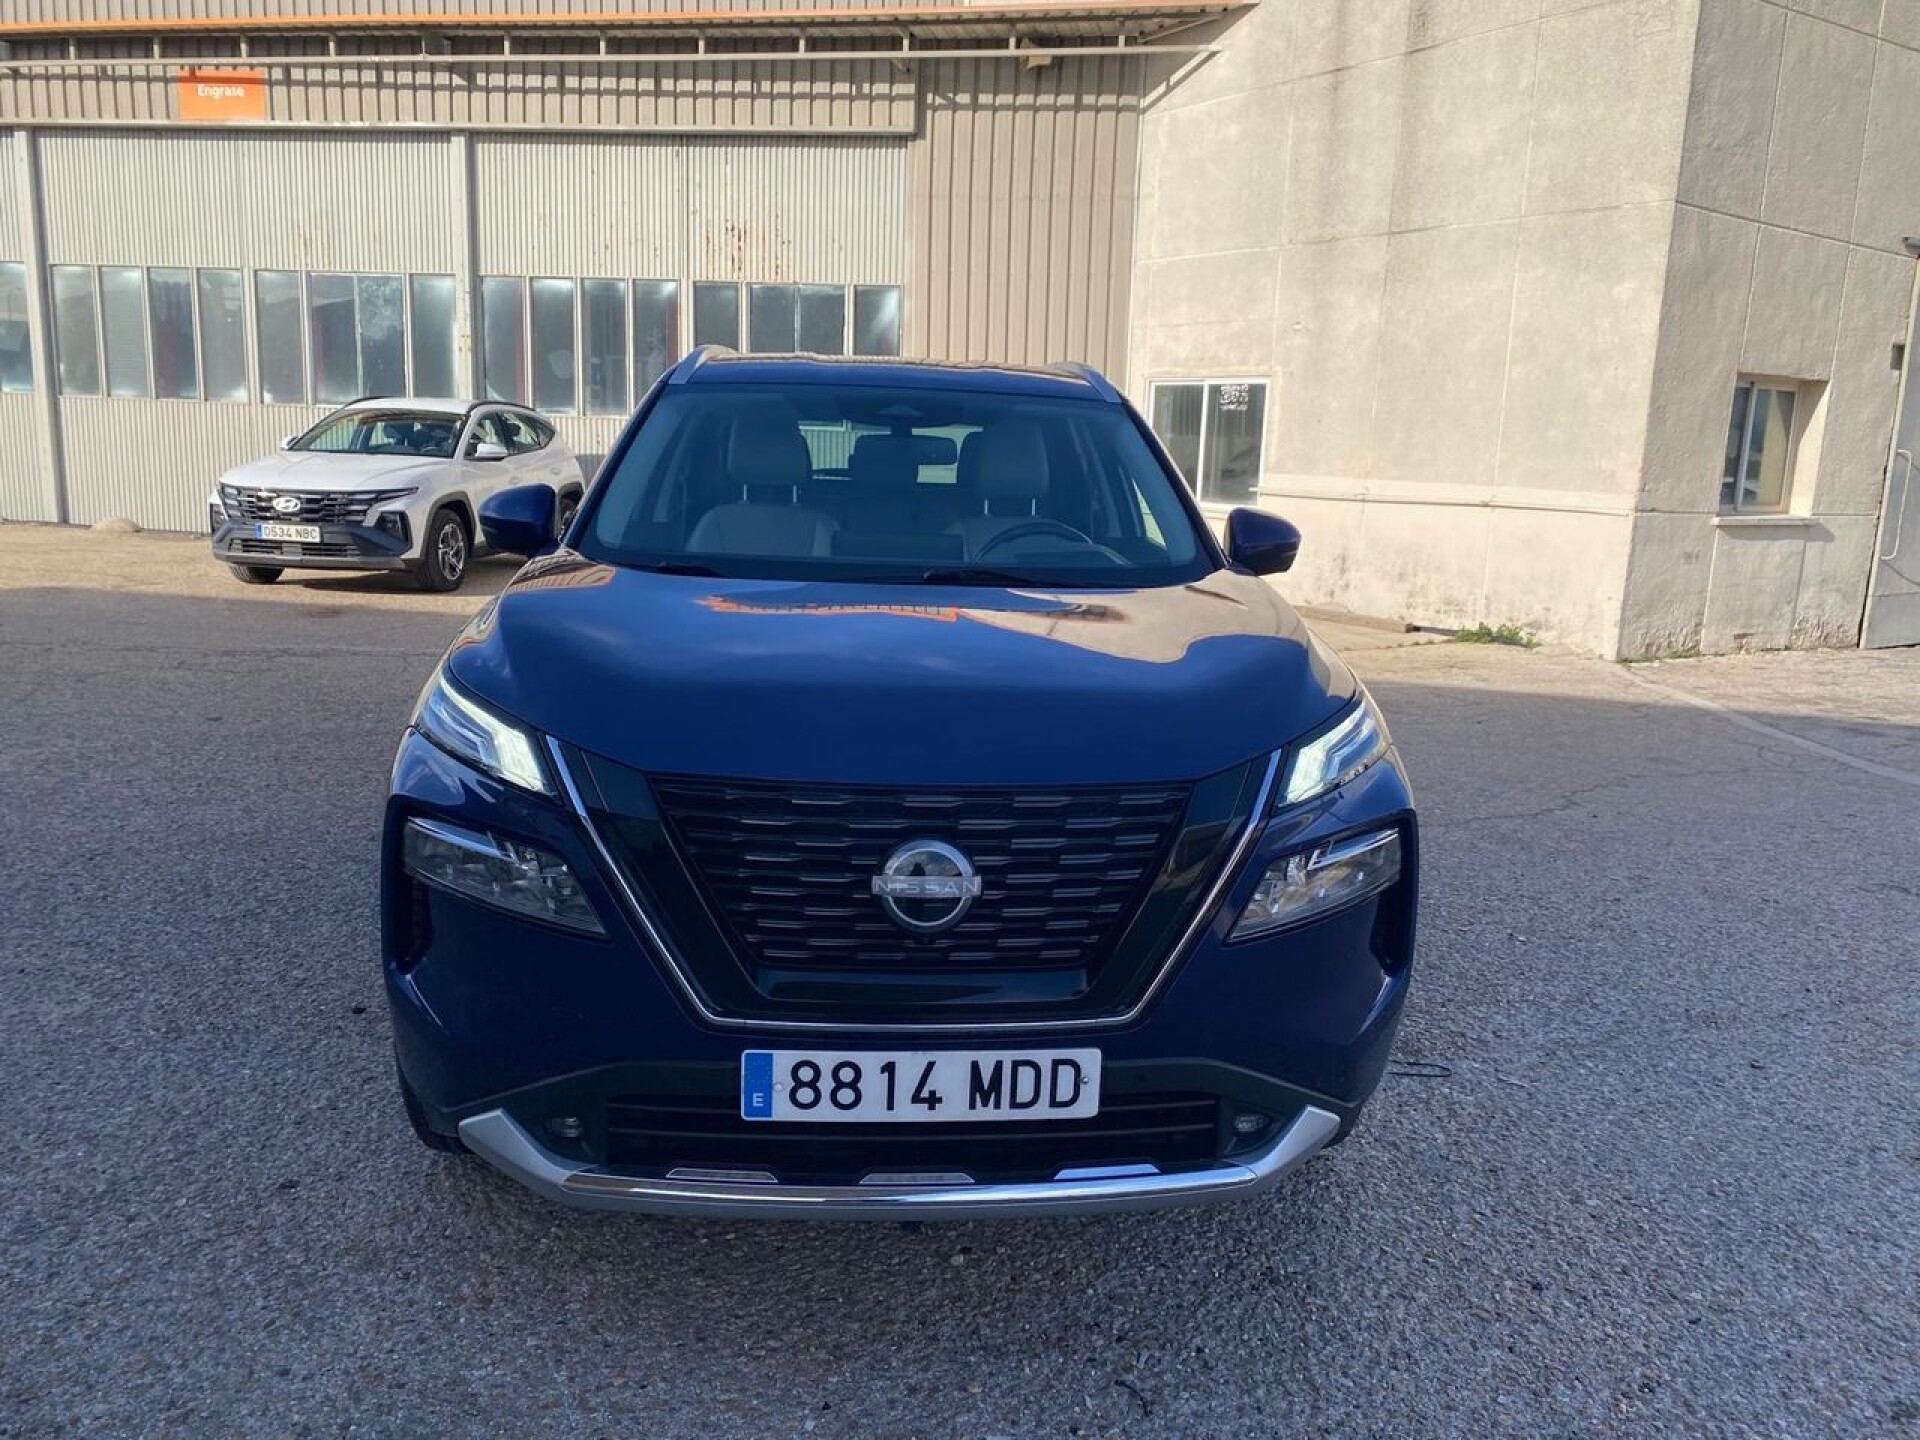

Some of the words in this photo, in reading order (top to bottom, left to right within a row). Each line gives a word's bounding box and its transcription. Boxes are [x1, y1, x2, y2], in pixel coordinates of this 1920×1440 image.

[197, 84, 244, 100] Engrase
[264, 526, 292, 538] 0534
[295, 527, 317, 539] NBC
[874, 880, 979, 893] NISSAN
[788, 1059, 943, 1111] 8814
[968, 1058, 1082, 1110] MDD
[752, 1093, 764, 1107] E
